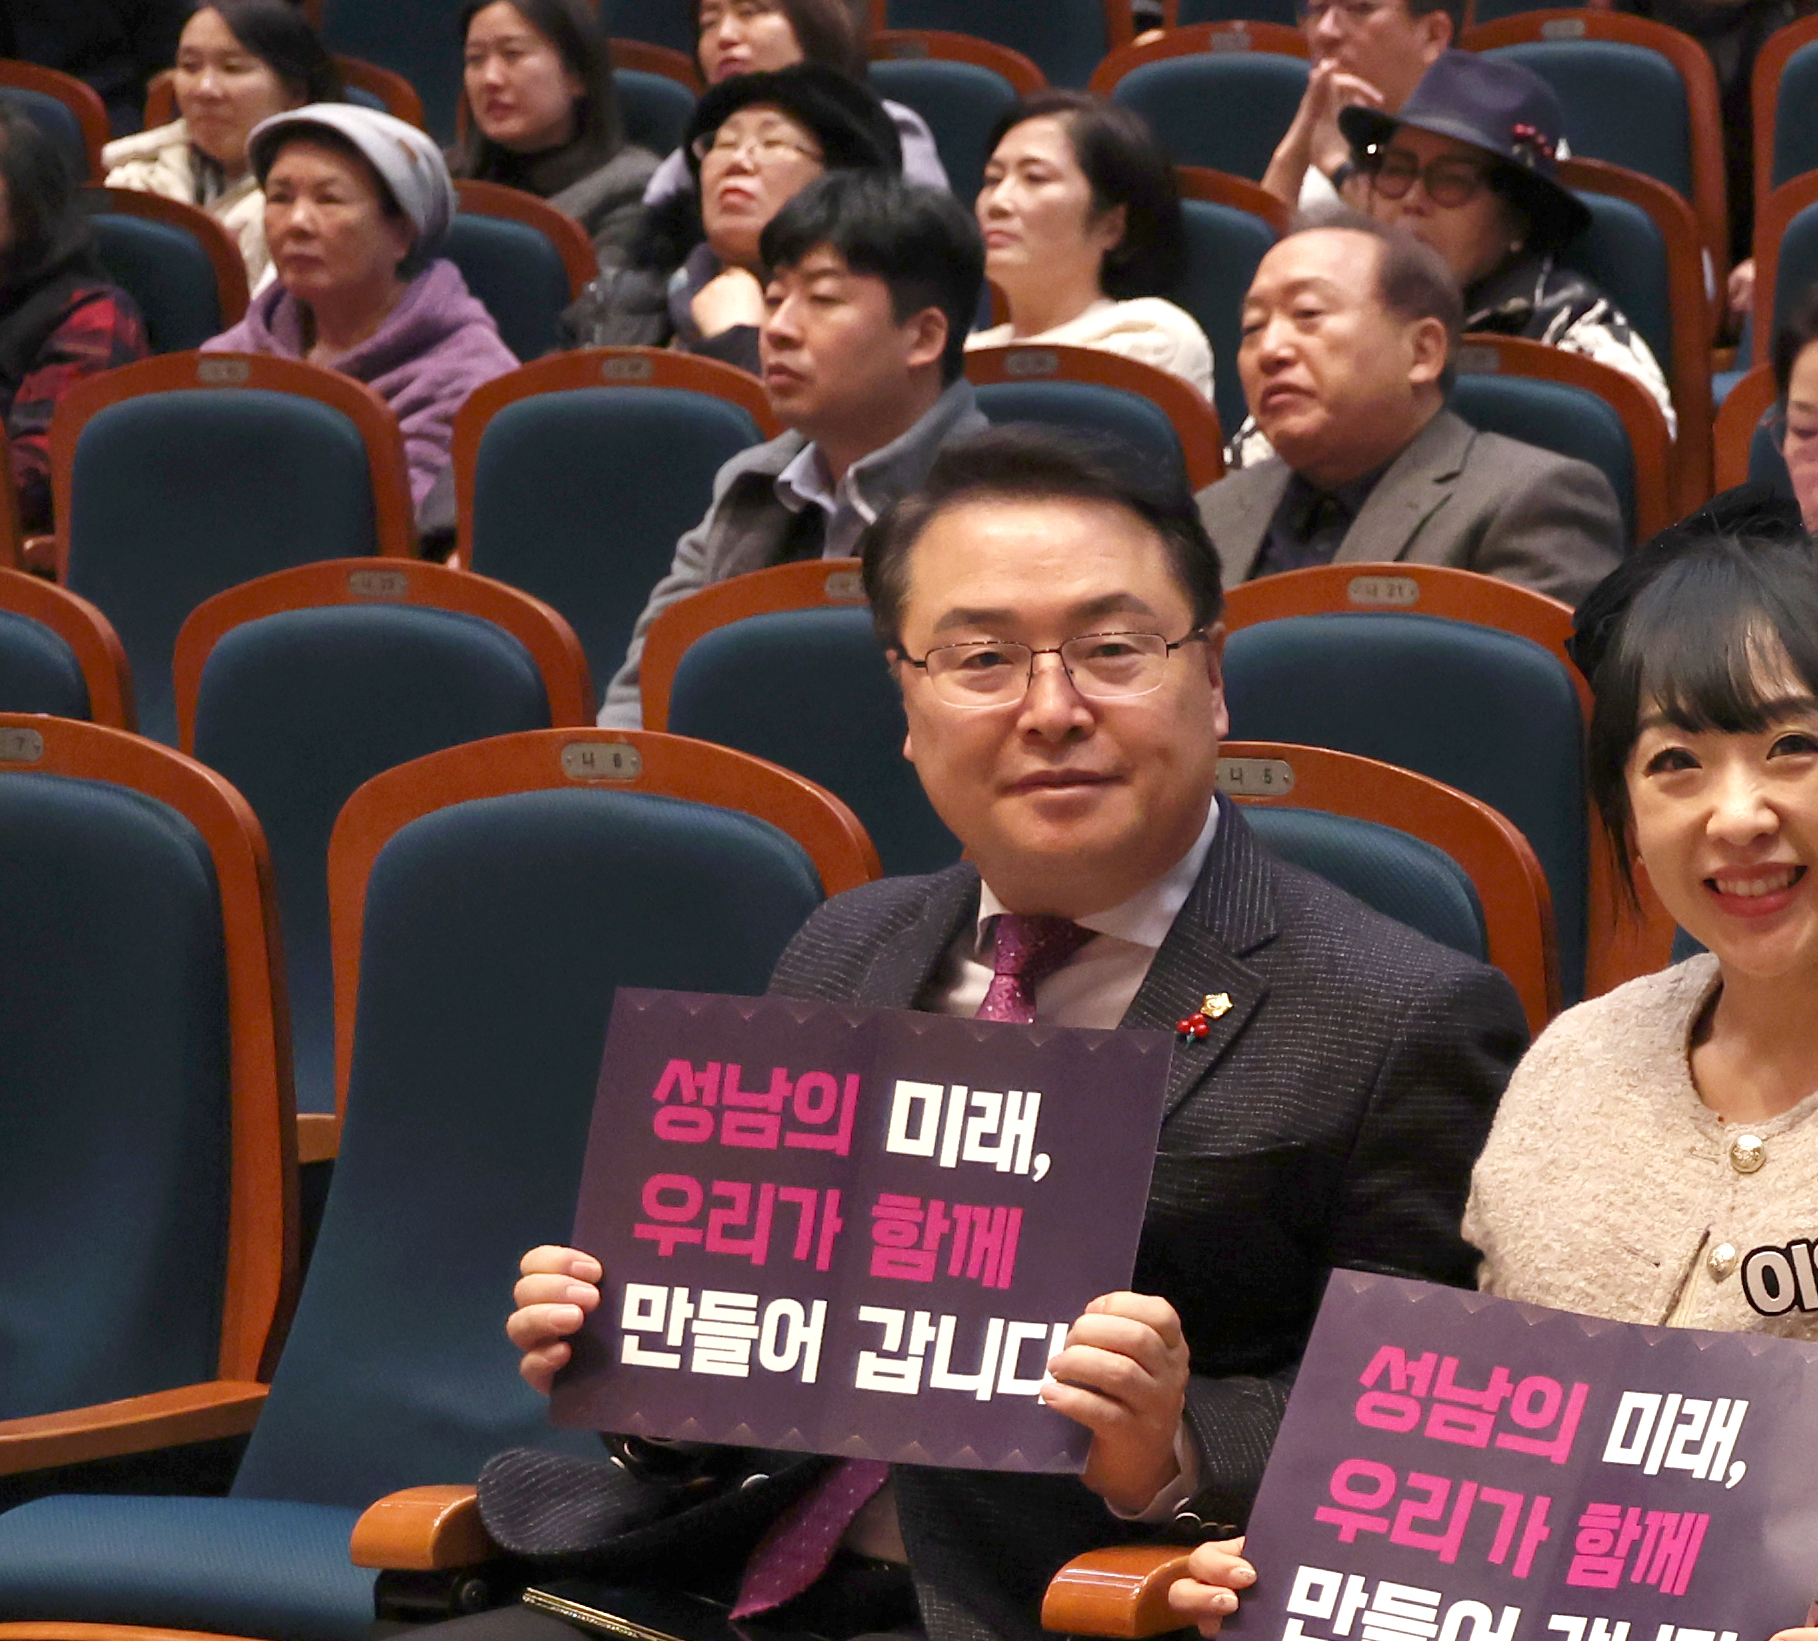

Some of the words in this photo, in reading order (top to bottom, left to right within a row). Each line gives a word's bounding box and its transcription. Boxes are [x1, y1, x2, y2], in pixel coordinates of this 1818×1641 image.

[1263, 768, 1272, 784] 5
[652, 1058, 861, 1157] 성남의
[885, 1079, 1053, 1182] 미래,
[633, 1172, 844, 1272] 우리가
[869, 1192, 1024, 1290] 함께
[621, 1282, 828, 1384] 만들어
[854, 1305, 1070, 1405] 갑니다
[1354, 1344, 1588, 1466] 성남의
[1602, 1390, 1750, 1489] 미래,
[1313, 1457, 1552, 1580] 우리가
[1564, 1502, 1711, 1597] 함께
